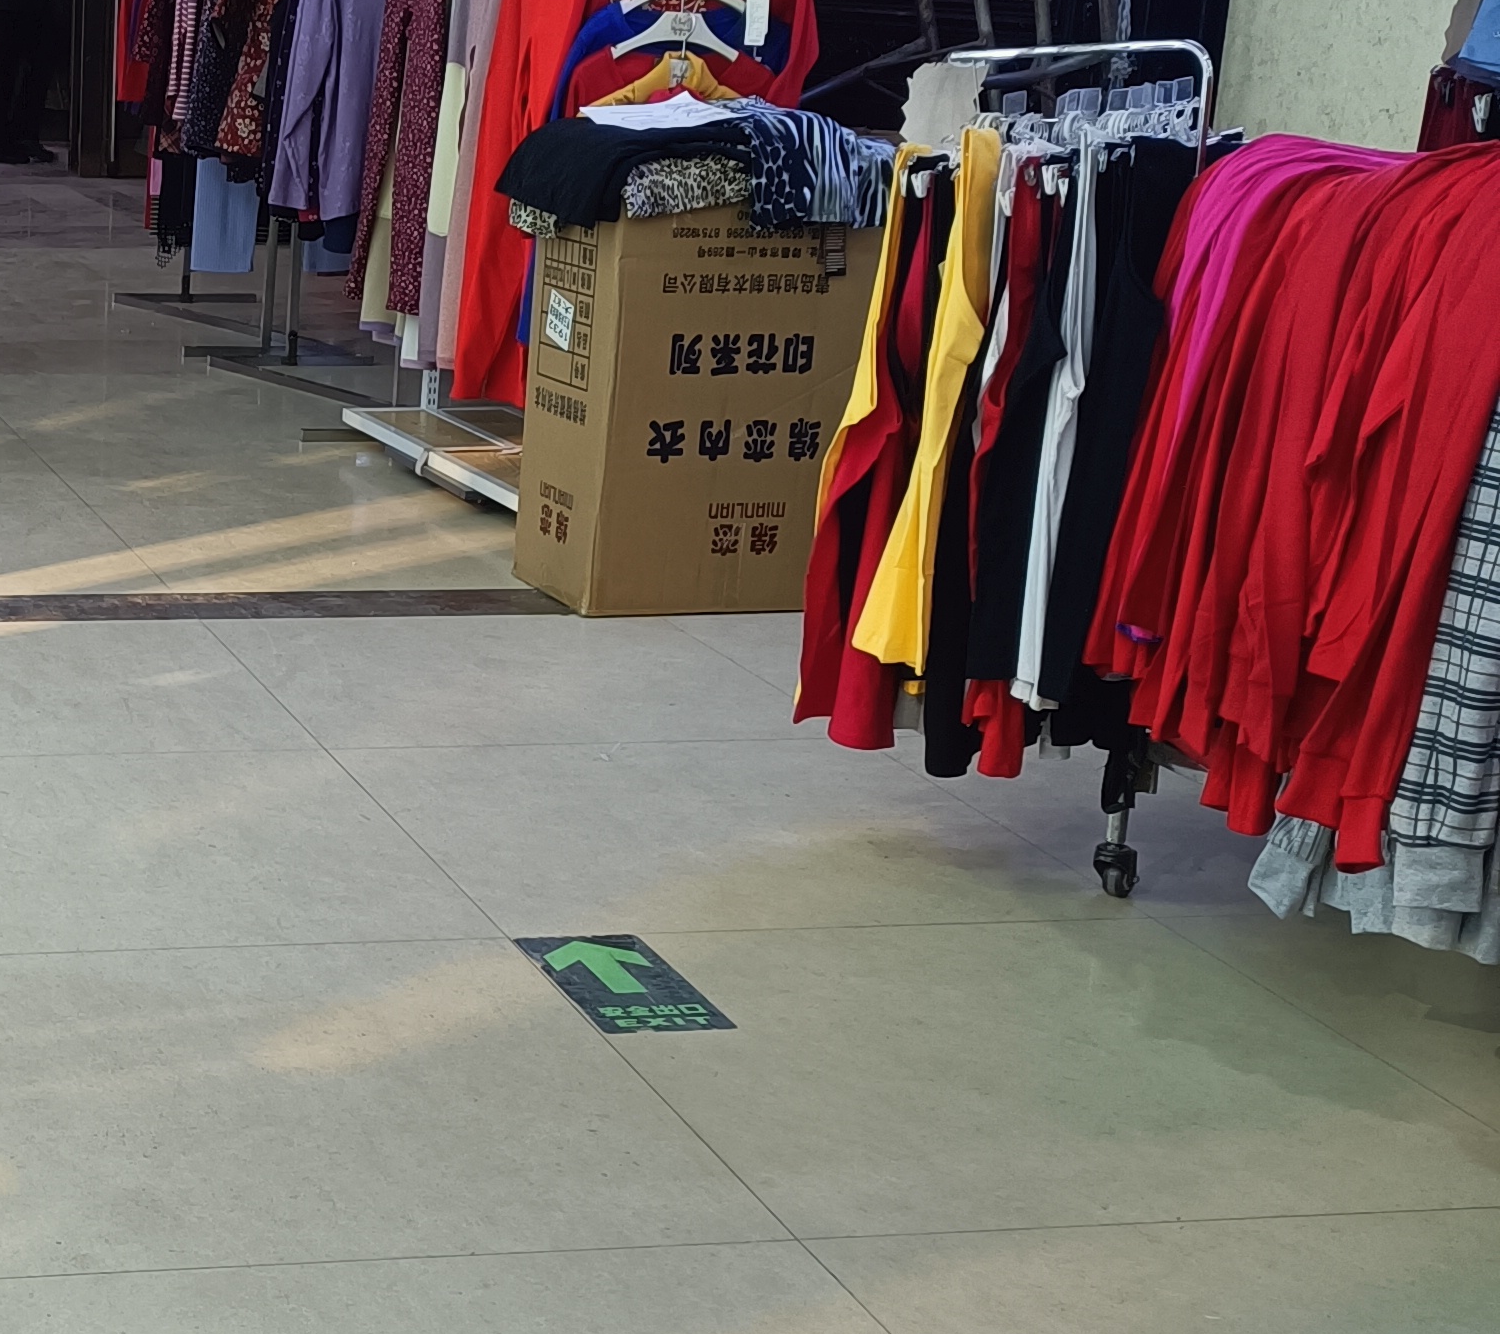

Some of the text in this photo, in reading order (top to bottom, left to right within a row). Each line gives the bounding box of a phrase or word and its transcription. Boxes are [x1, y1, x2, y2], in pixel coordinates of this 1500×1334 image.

[662, 272, 830, 296] 青岛旭旭制衣有限公司
[669, 332, 816, 377] 印花系列
[645, 418, 822, 464] 绵恋内衣
[711, 522, 780, 557] 绵恋
[598, 1004, 708, 1017] 安全出口
[614, 1017, 710, 1028] EXIT
